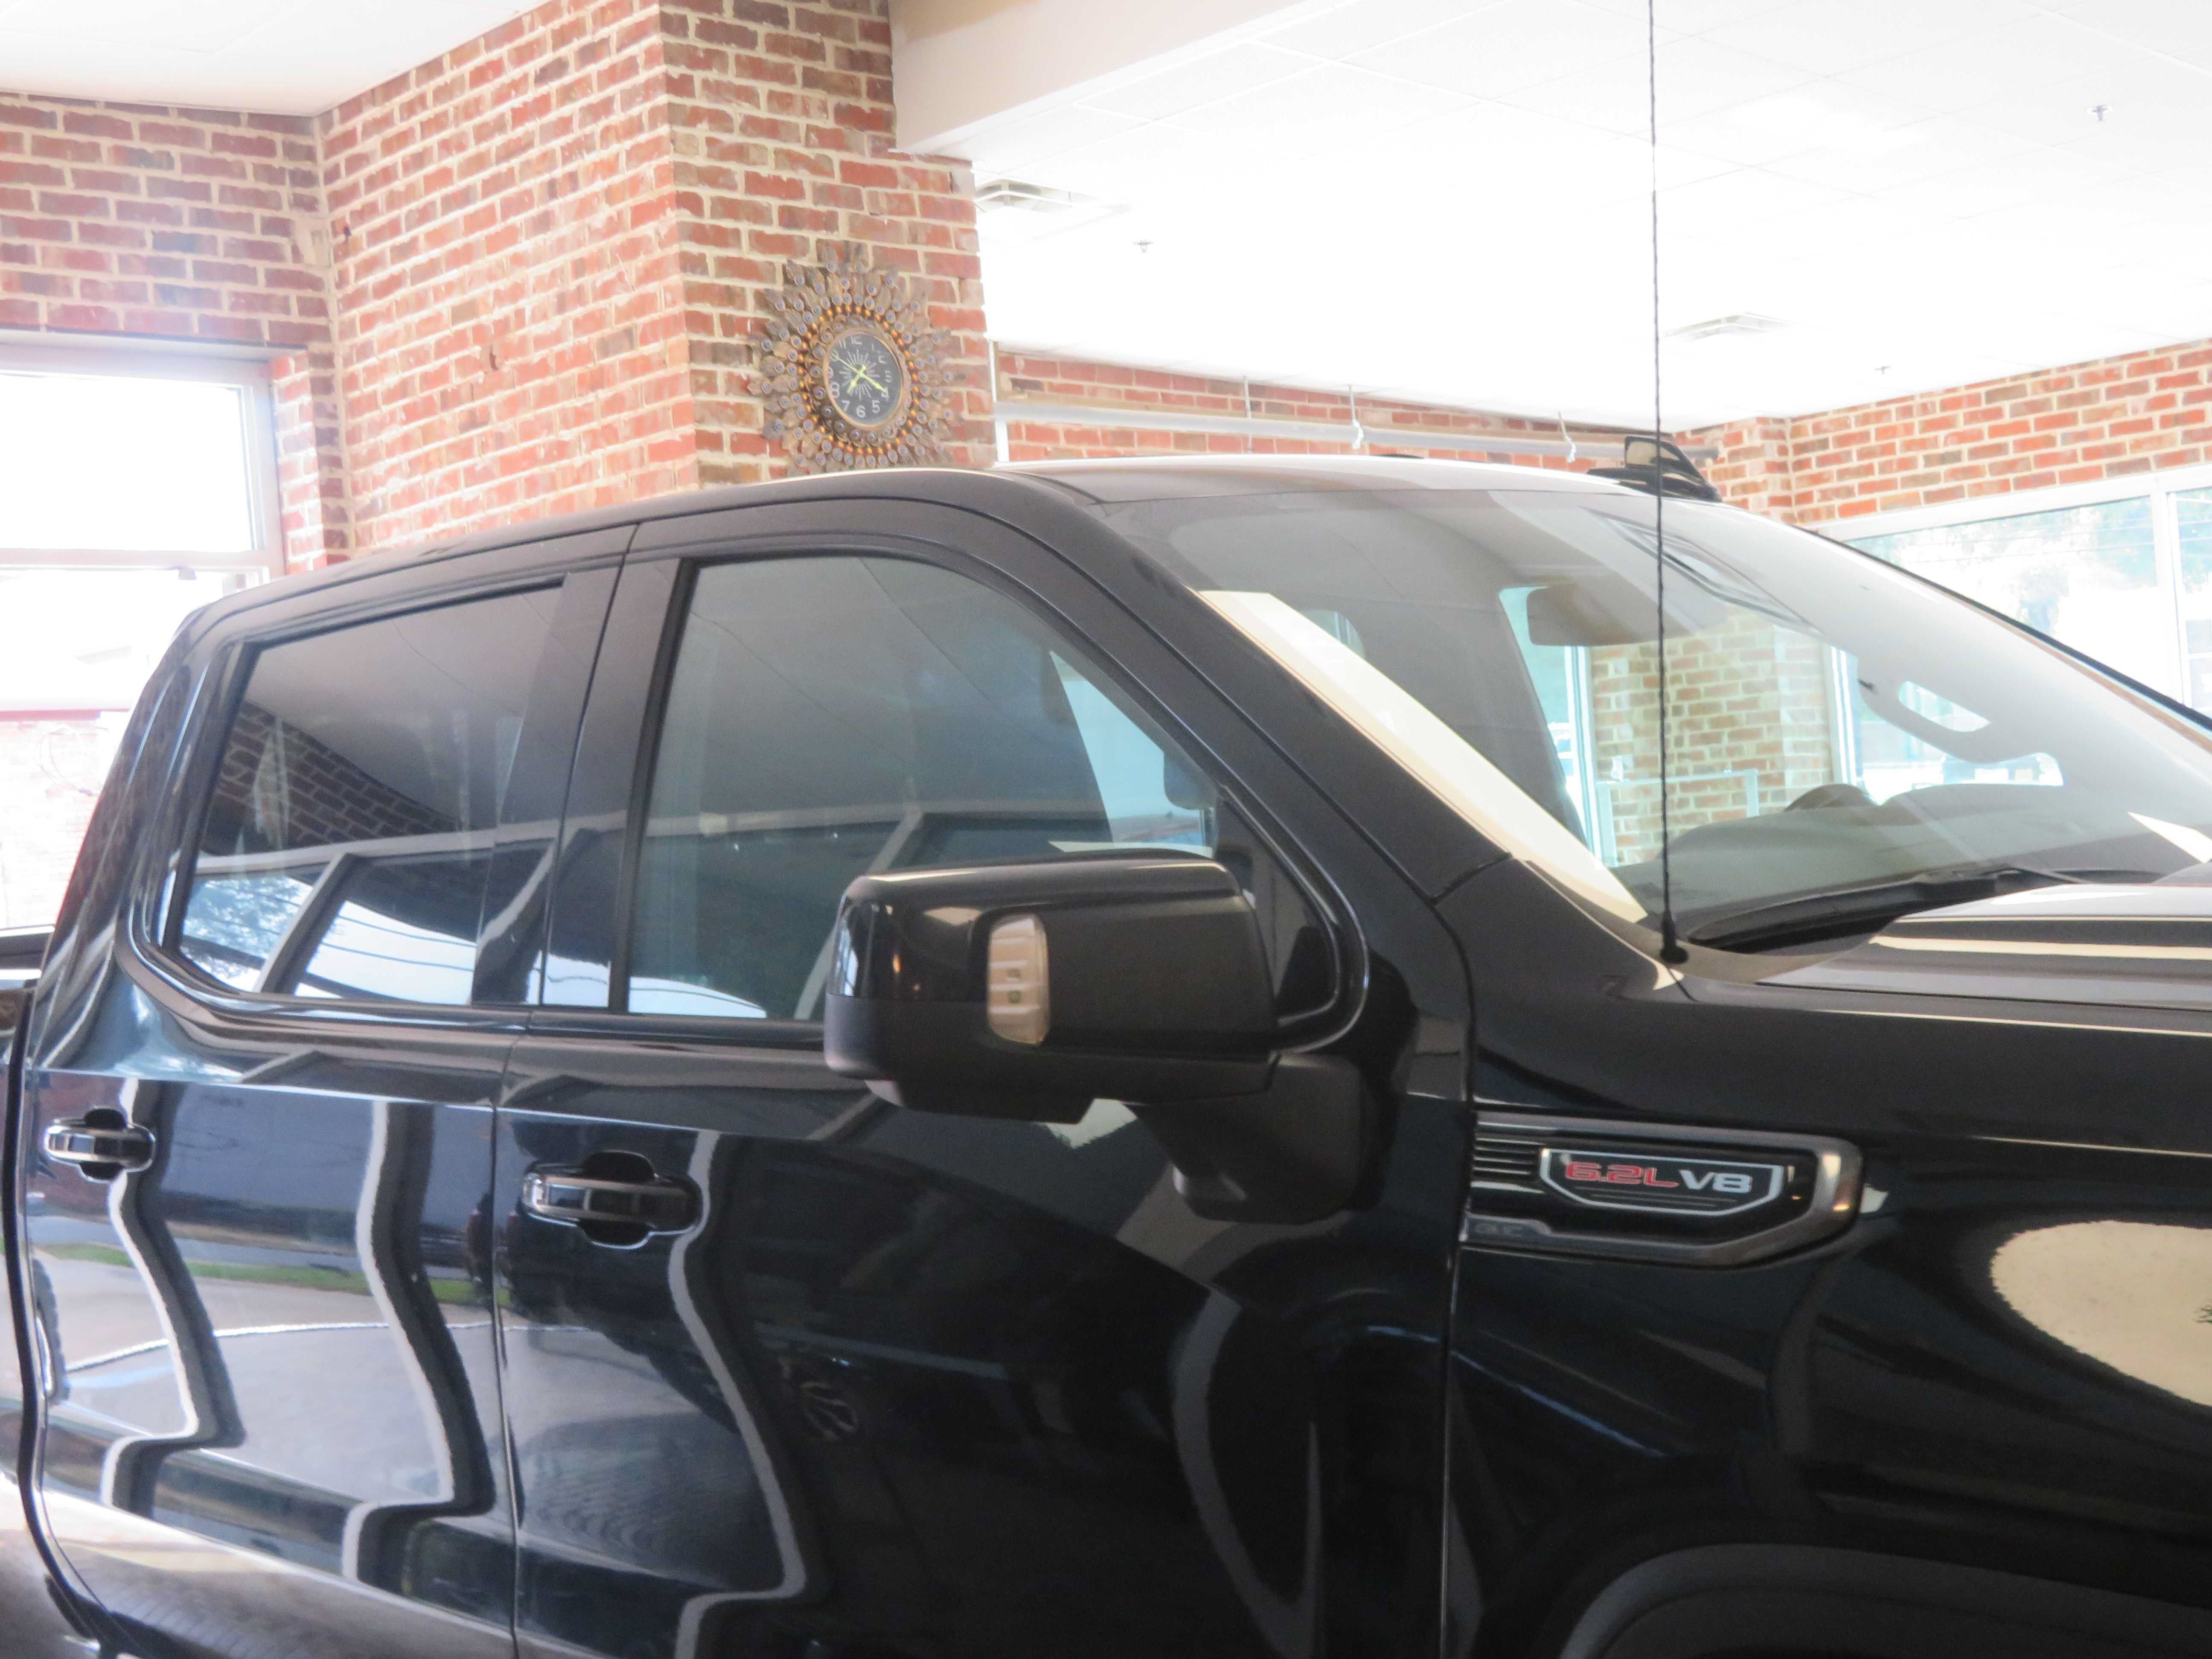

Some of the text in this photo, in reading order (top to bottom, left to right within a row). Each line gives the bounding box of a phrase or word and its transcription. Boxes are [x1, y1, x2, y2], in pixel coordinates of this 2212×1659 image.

[829, 381, 840, 399] 8
[841, 400, 850, 413] 7
[856, 405, 866, 418] 6
[872, 399, 880, 413] 5
[1566, 1161, 1753, 1193] 6.2L V8
